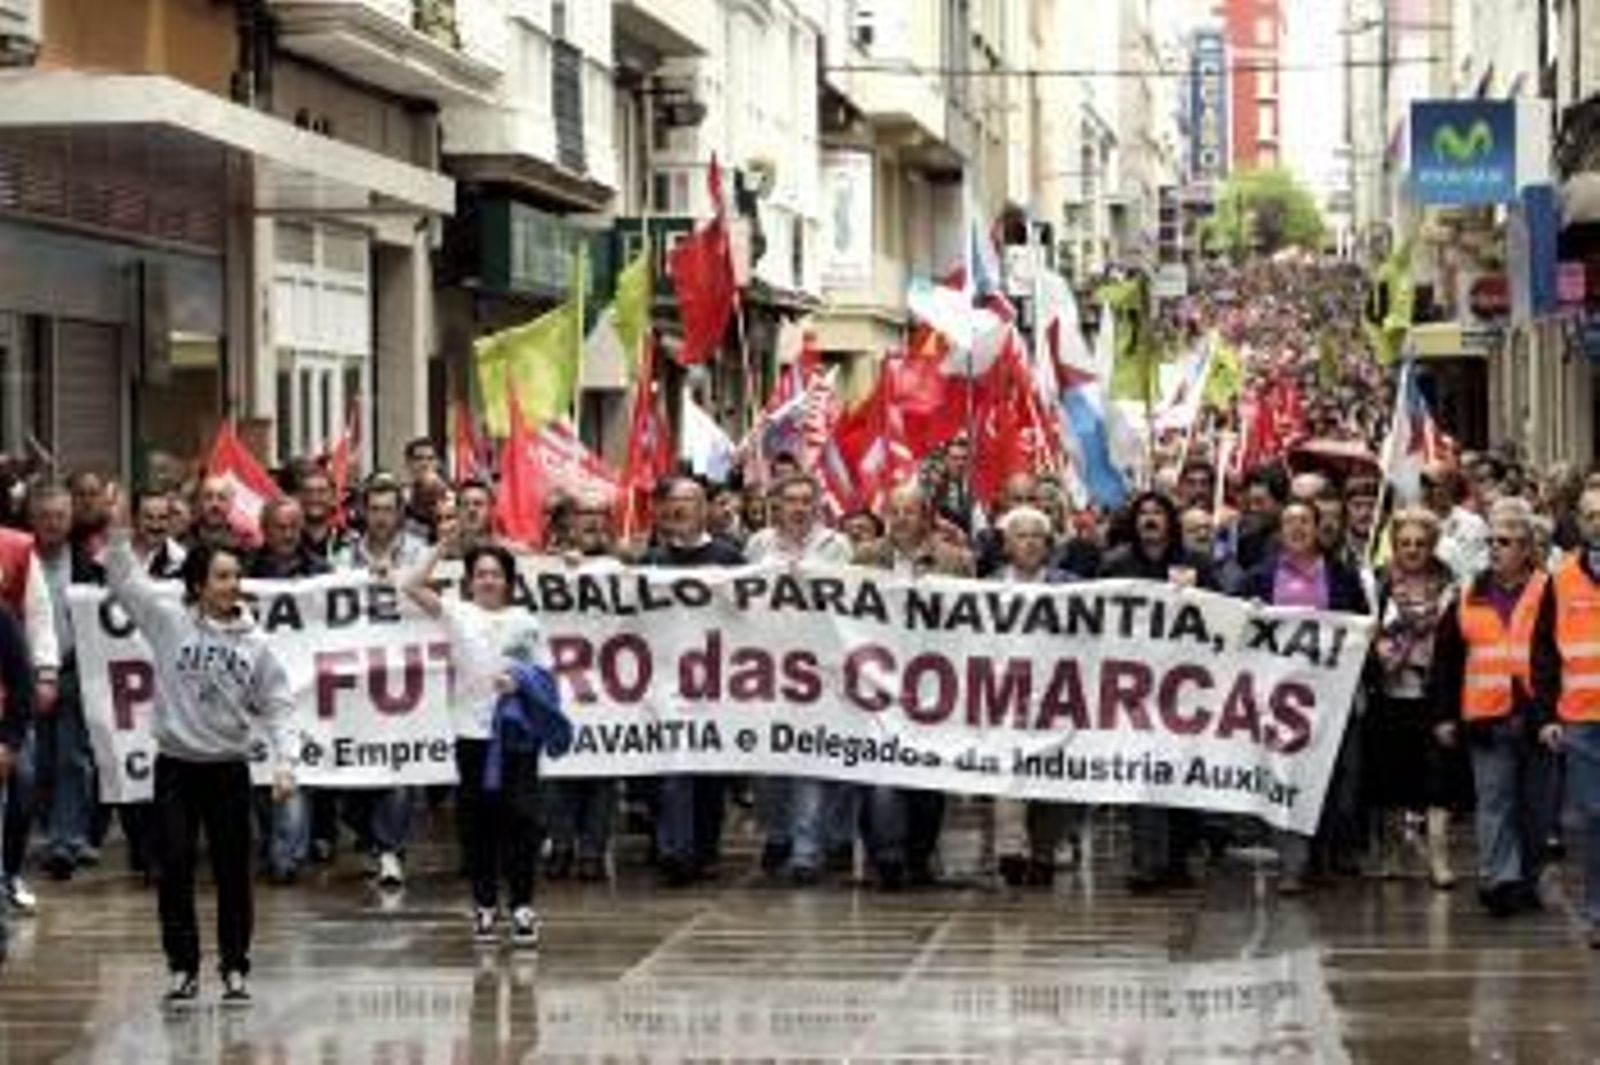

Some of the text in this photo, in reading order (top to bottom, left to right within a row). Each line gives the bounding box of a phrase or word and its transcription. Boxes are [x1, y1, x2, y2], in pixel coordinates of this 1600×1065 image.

[326, 585, 400, 628] DE
[733, 574, 888, 623] PARA
[905, 588, 1224, 653] NAVANTIA,
[1247, 619, 1347, 668] XA!
[315, 632, 653, 720] FUTRO
[678, 629, 822, 702] das
[843, 645, 1316, 753] COMARCAS
[564, 720, 721, 754] AVANTIA
[734, 728, 757, 752] e
[771, 724, 942, 767] Delegados
[1013, 747, 1174, 785] Industria
